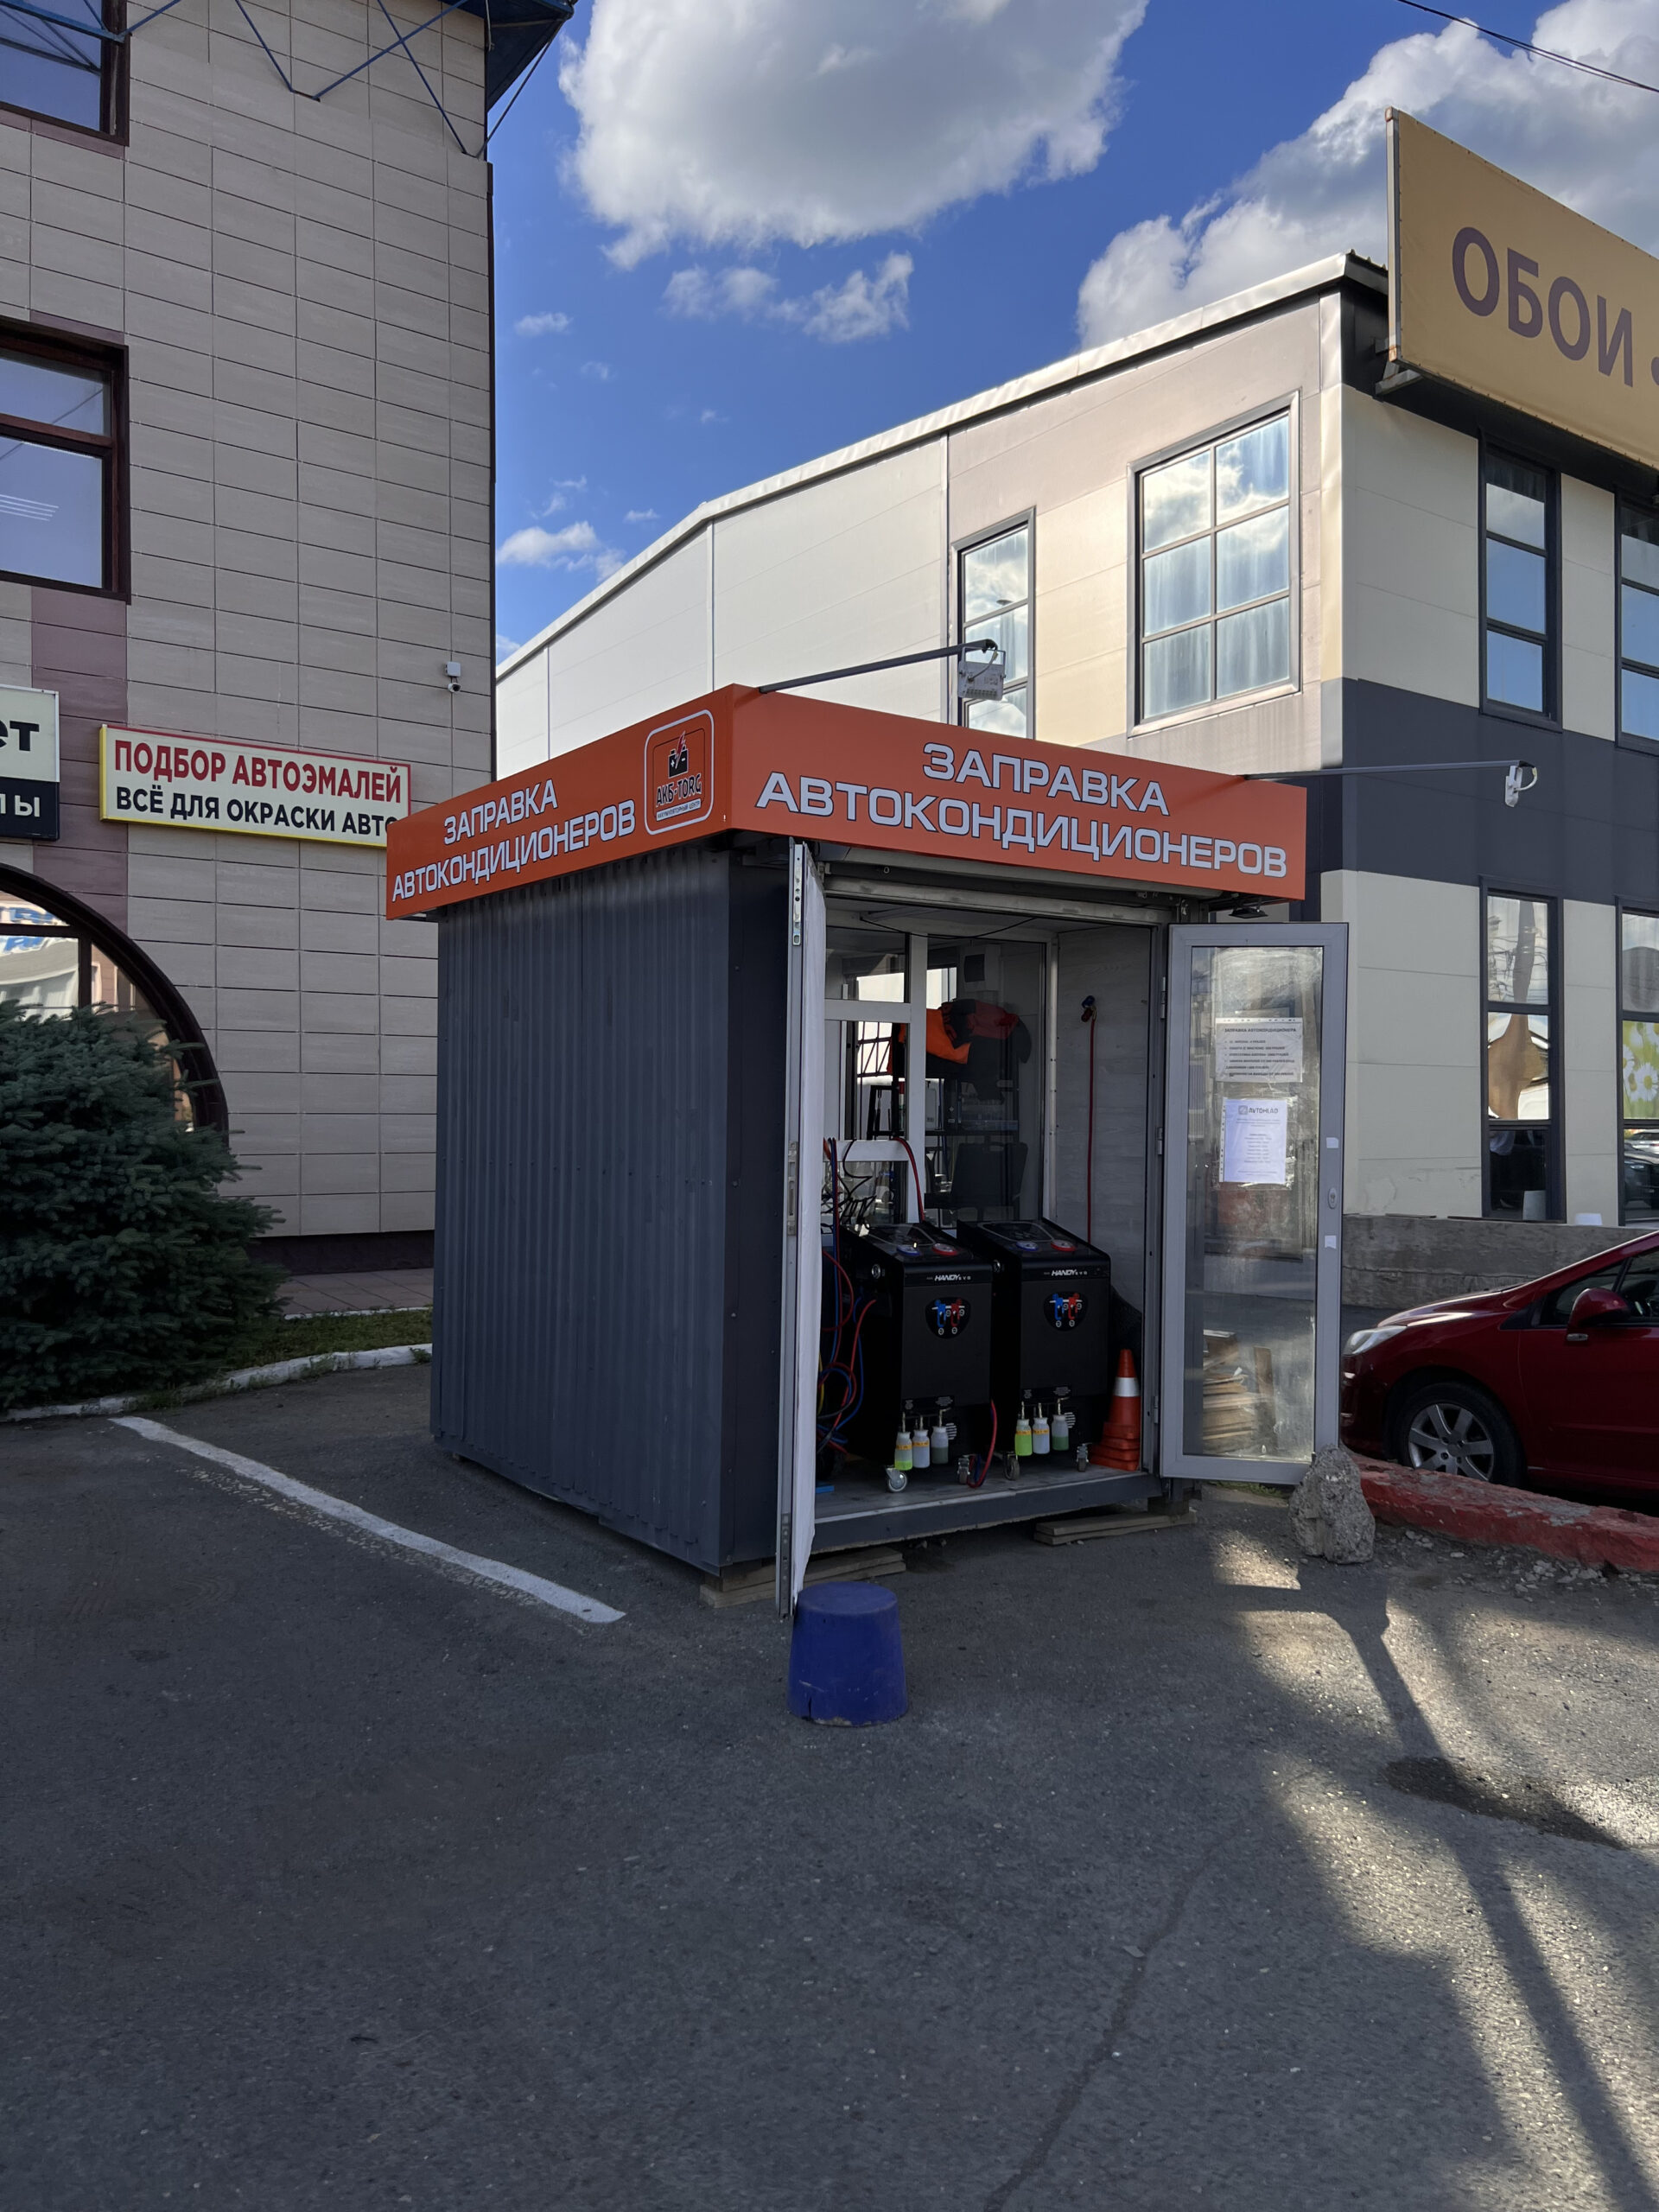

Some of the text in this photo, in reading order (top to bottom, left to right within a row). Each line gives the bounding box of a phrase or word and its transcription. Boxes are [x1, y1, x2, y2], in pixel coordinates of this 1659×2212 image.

[1452, 226, 1633, 388] ОБОИ
[115, 740, 401, 804] ПОДБОР АВТОЭМАЛЕЙ
[117, 785, 164, 814] ВСЁ
[170, 792, 219, 820] ДЛЯ
[226, 799, 335, 832] ОКРАСКИ
[922, 741, 1171, 817] ЗАПРАВКА
[391, 798, 637, 902] АВТОКОНДИЦИОНЕРОВ
[443, 779, 558, 845] ЗАПРАВКА
[754, 771, 1287, 879] АВТОКОНДИЦИОНЕРОВ
